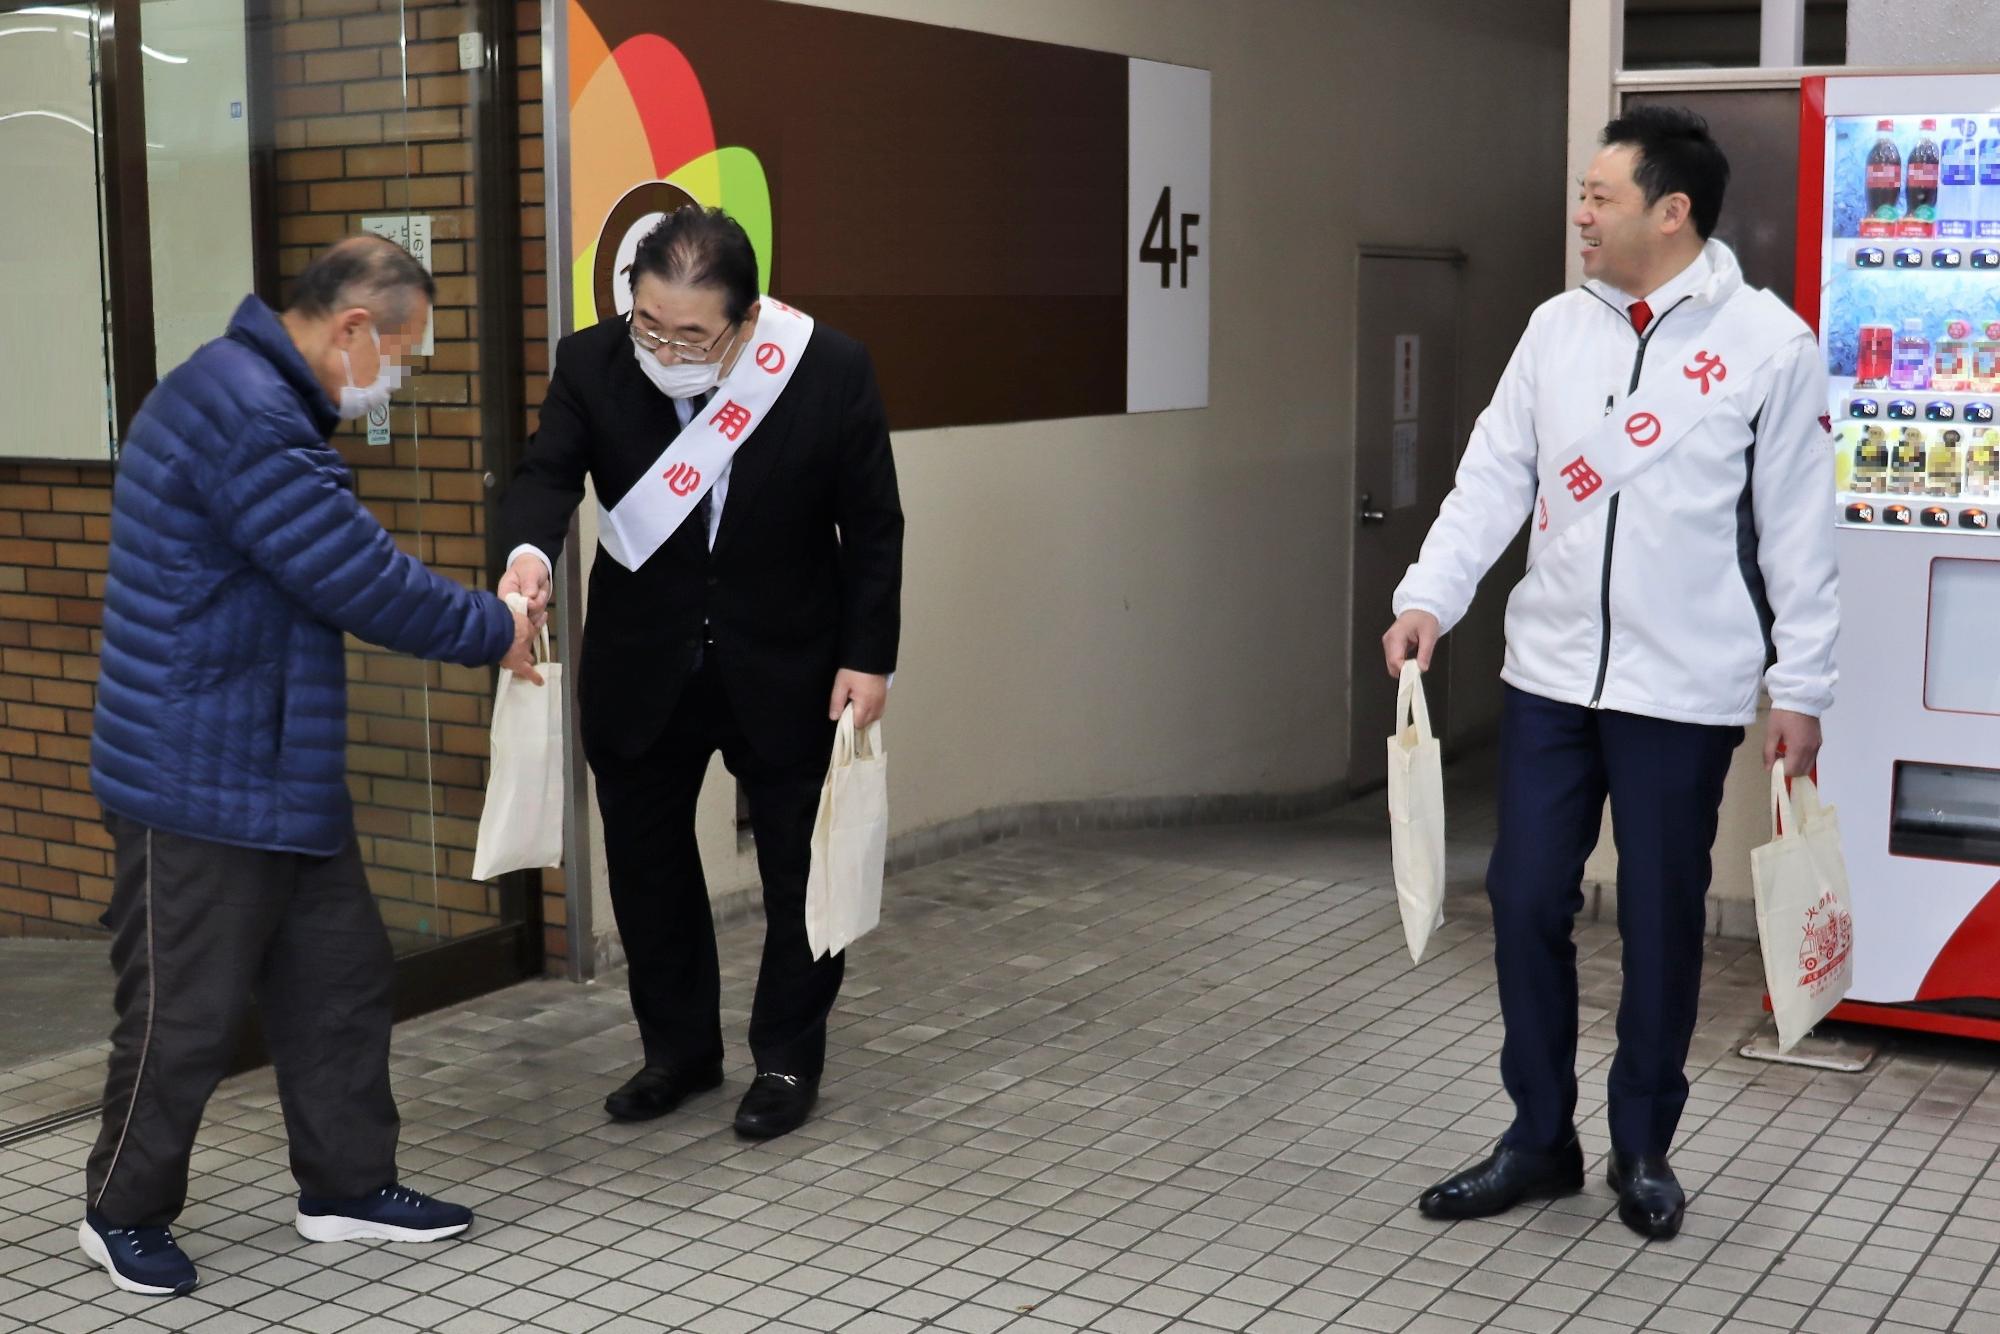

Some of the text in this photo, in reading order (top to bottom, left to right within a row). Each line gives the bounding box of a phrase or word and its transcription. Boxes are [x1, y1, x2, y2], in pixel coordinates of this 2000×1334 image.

[1139, 186, 1200, 289] 4F
[663, 299, 803, 497] の用心
